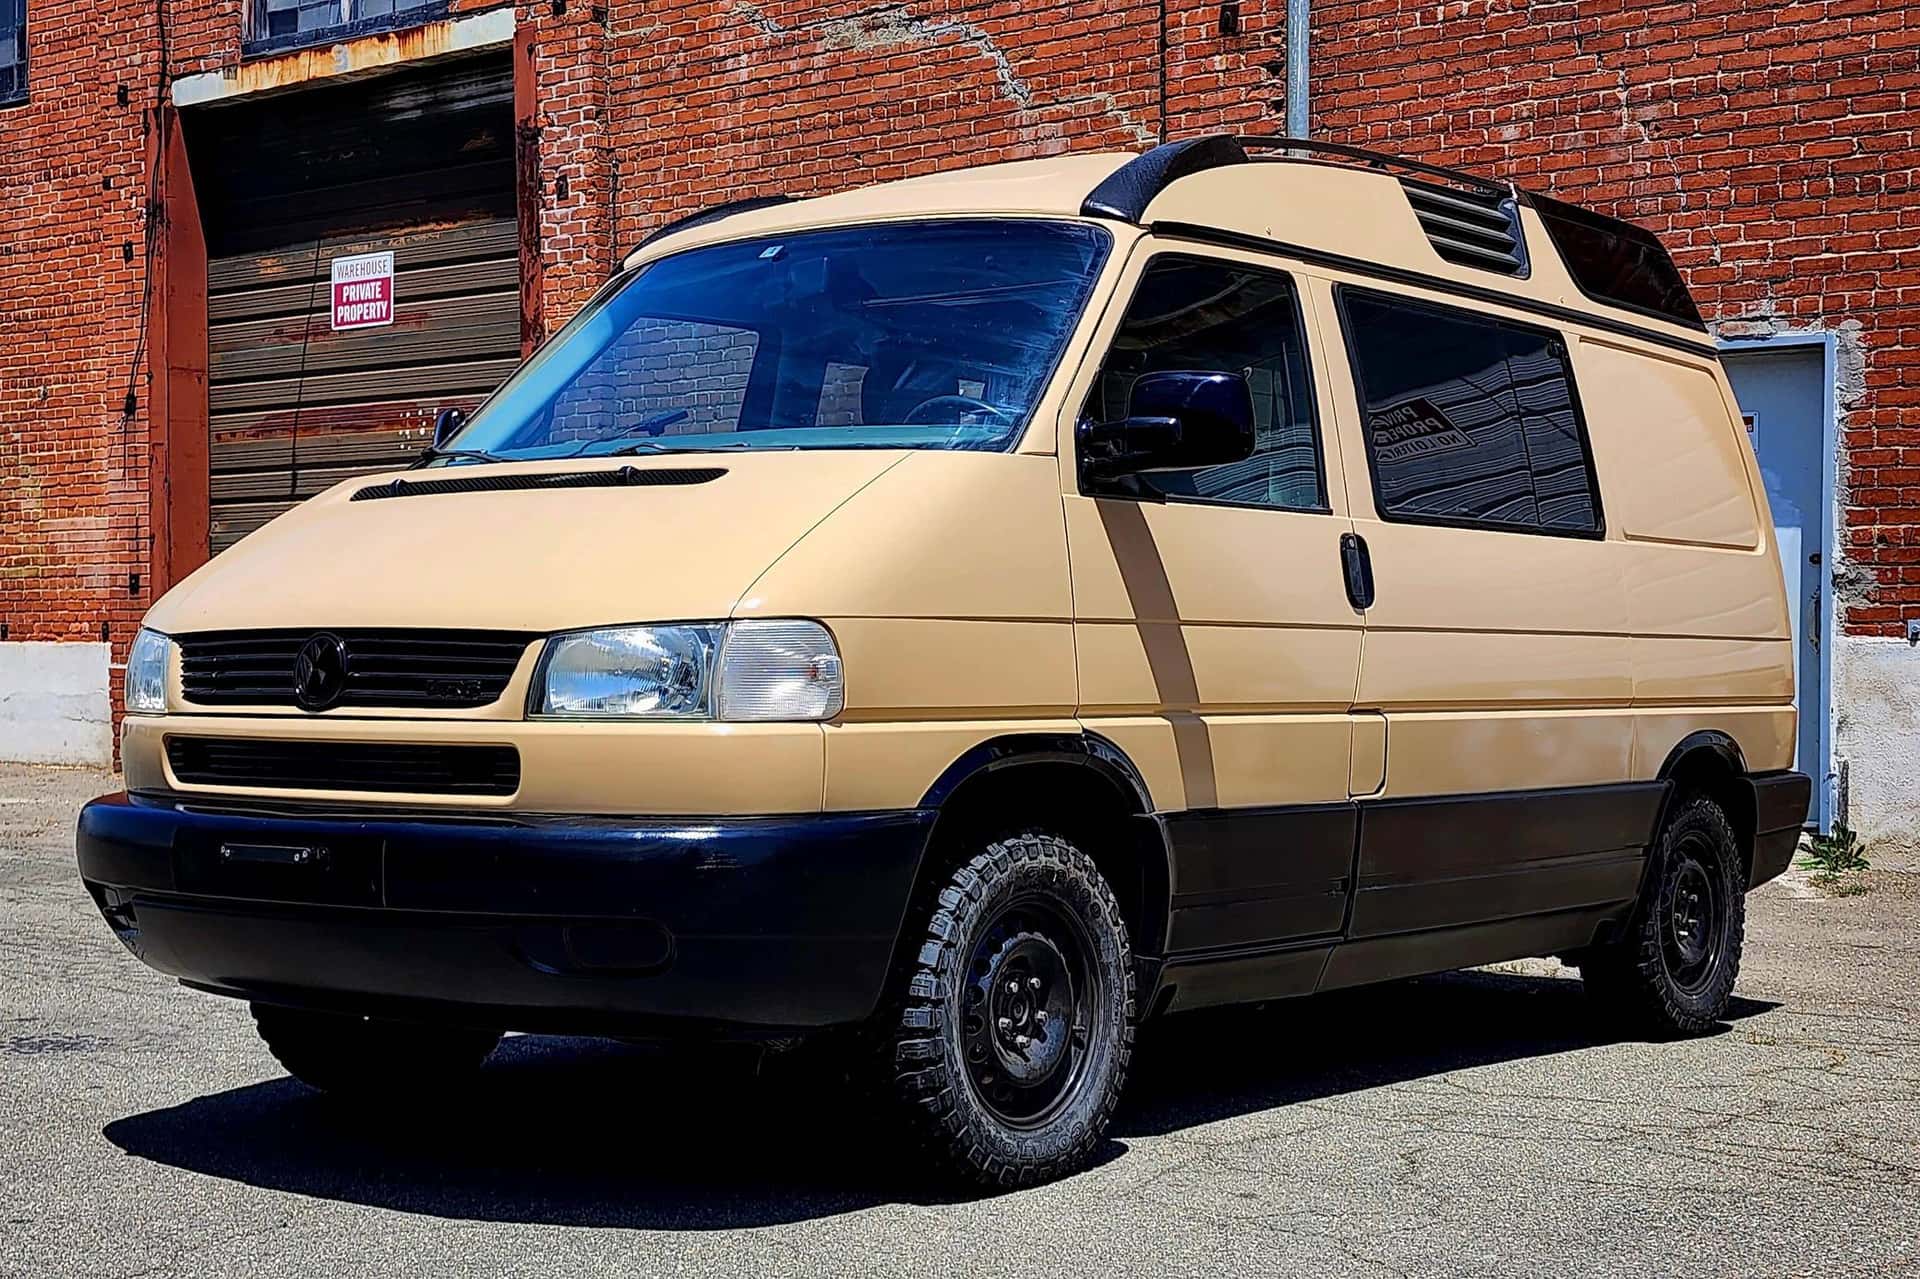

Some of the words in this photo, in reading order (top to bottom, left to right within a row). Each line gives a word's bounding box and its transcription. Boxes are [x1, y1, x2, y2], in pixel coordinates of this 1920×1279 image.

[336, 259, 388, 279] WAREHOUSE
[343, 281, 382, 303] PRIVATE
[337, 300, 388, 323] PROPERTY
